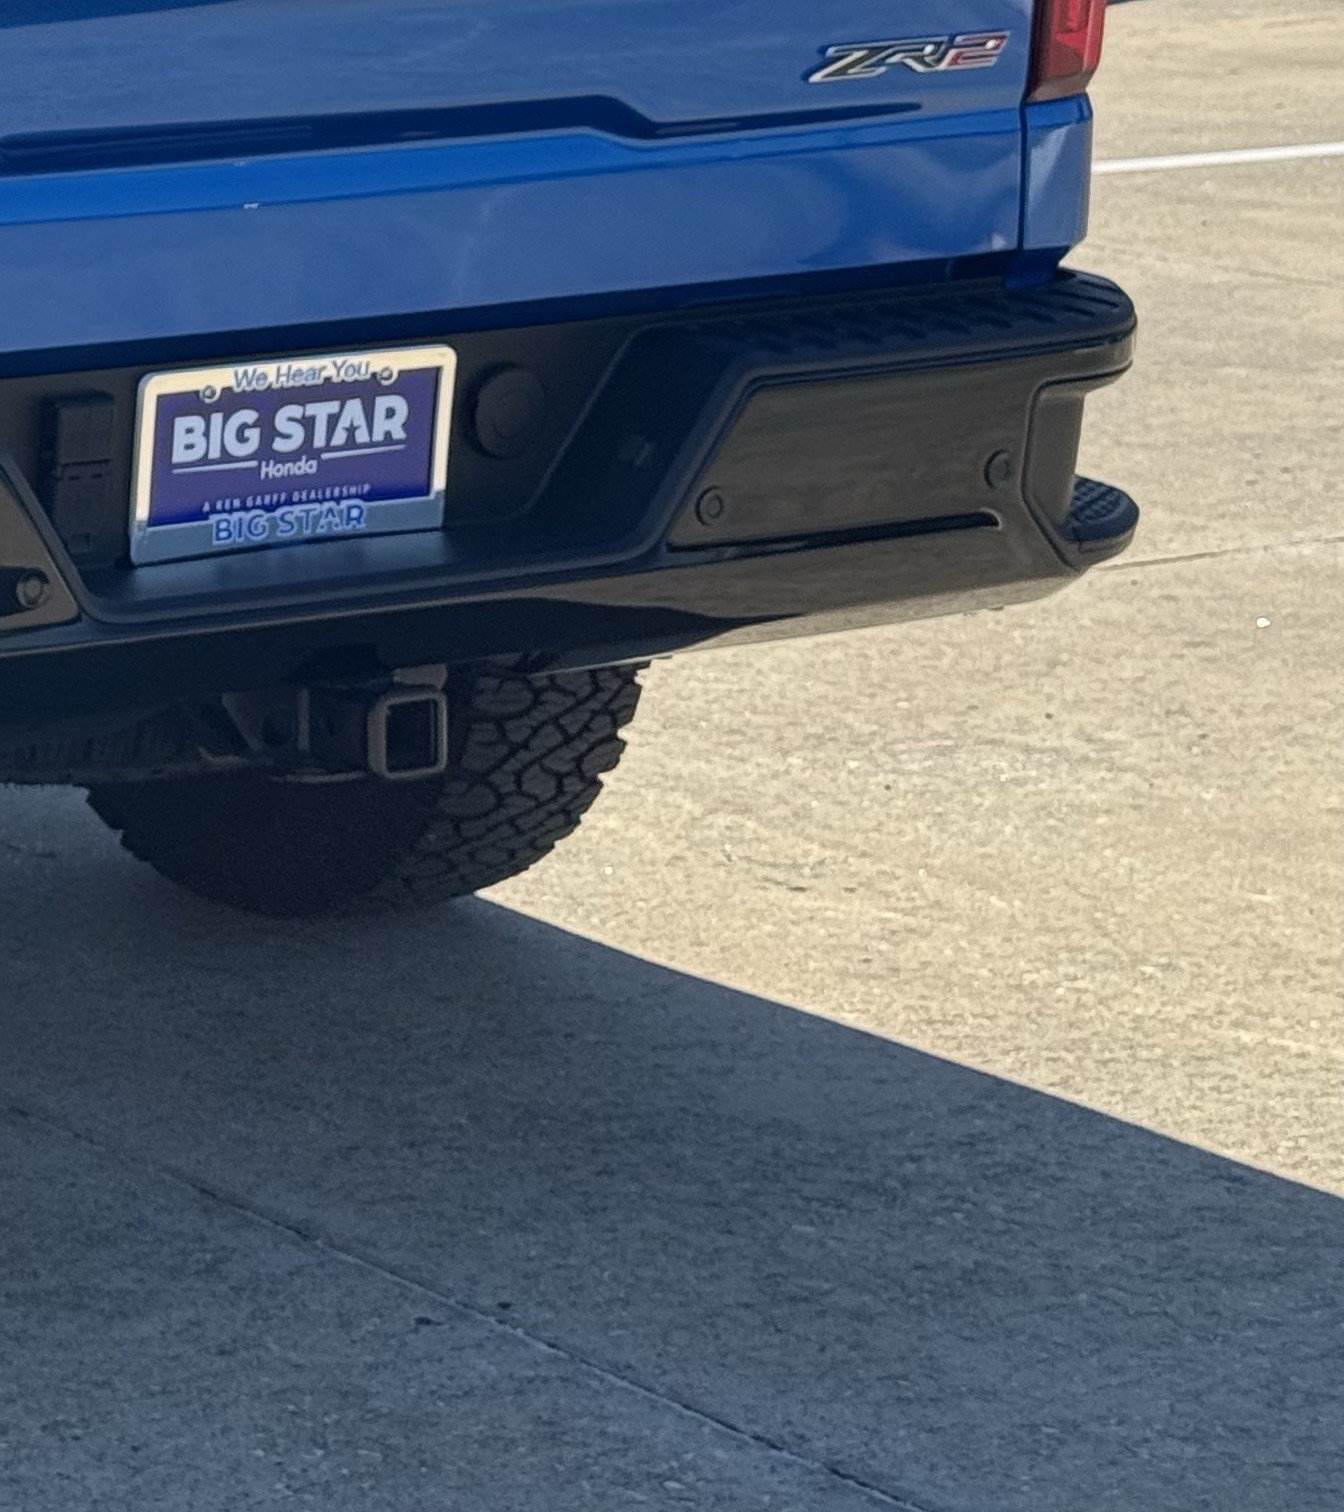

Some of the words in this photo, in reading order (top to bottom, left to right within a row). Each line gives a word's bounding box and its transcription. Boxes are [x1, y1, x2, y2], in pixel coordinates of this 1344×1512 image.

[808, 29, 1011, 83] ZR2
[233, 367, 267, 390] We
[273, 363, 325, 388] Hear
[328, 359, 371, 383] You
[171, 409, 261, 464] BIG
[272, 395, 409, 453] STAR
[260, 455, 318, 481] Honda
[213, 513, 268, 543] BIG
[276, 503, 366, 537] STAR
